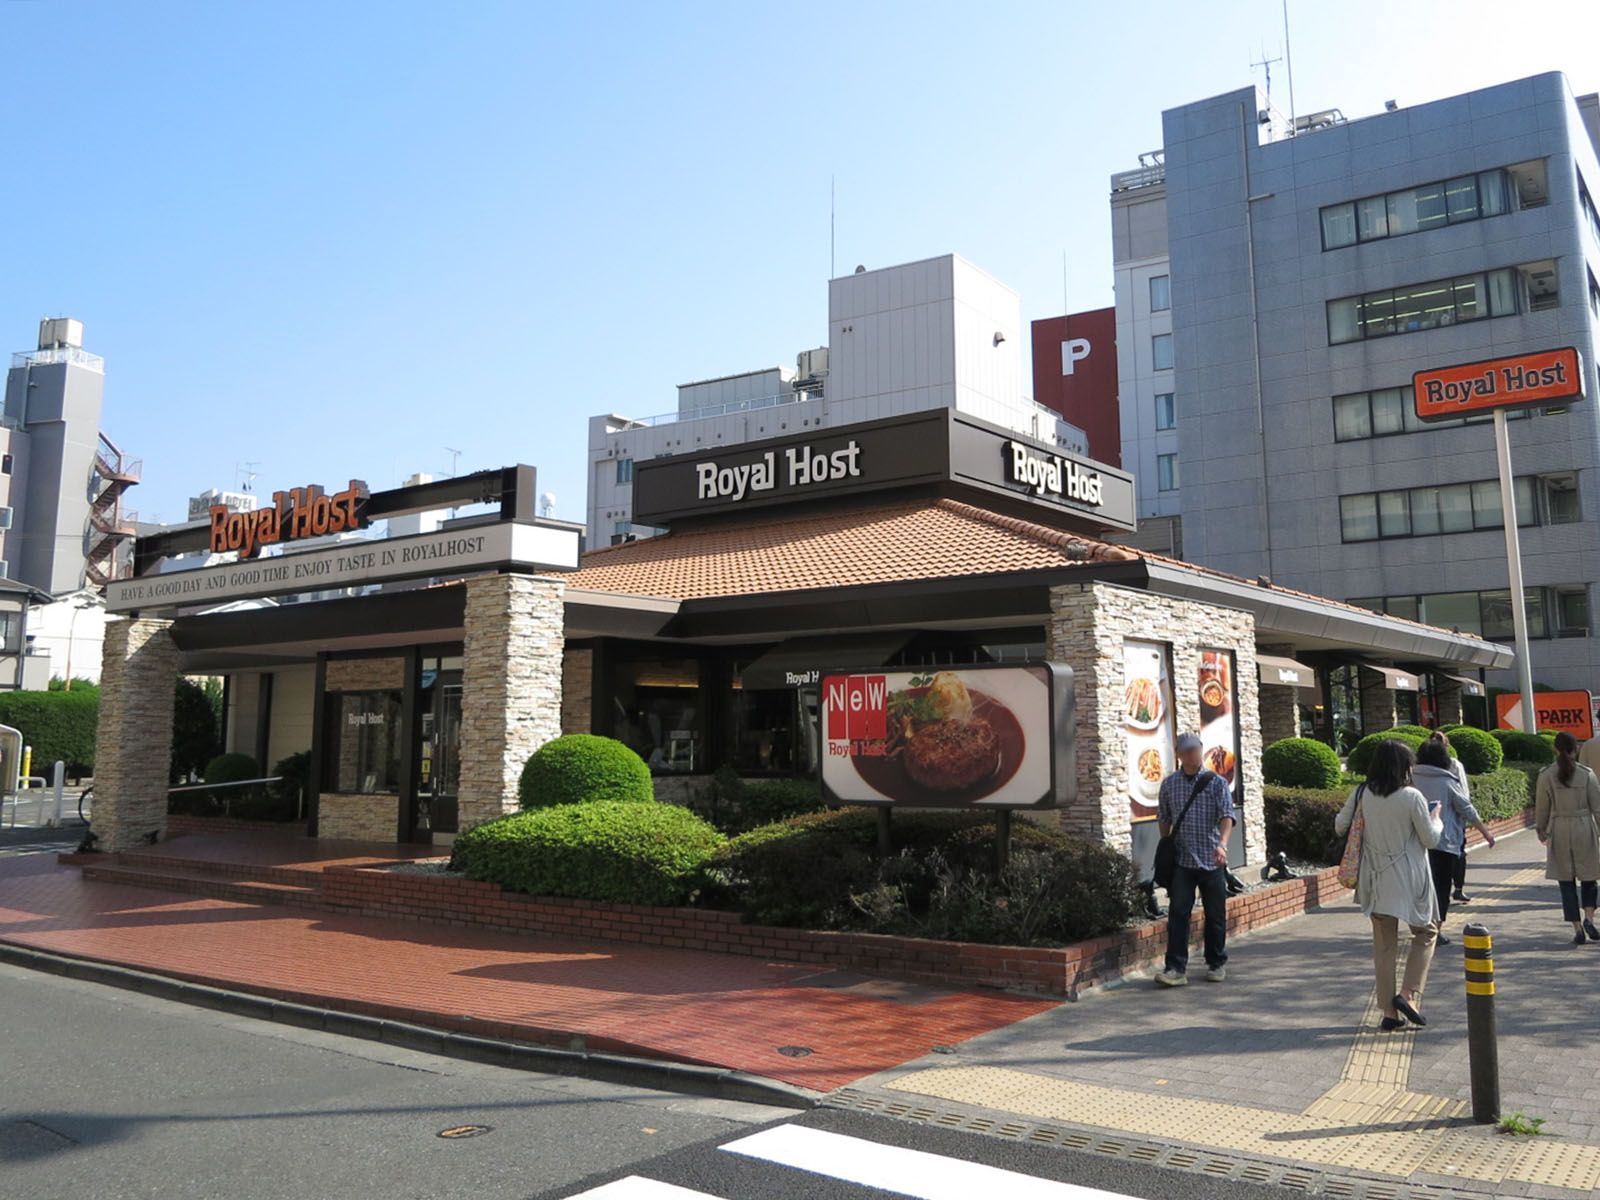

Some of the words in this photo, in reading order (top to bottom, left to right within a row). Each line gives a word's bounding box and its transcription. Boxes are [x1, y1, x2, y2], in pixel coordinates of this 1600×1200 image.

[1061, 338, 1091, 376] P
[1424, 371, 1496, 404] Royal
[1503, 361, 1566, 391] Host
[696, 452, 775, 501] Royal
[785, 441, 861, 486] Host
[1011, 441, 1062, 495] Royal
[1064, 461, 1104, 506] Host
[209, 491, 282, 558] Royal
[289, 479, 362, 538] Host
[121, 587, 144, 601] HAVE
[148, 588, 154, 599] A
[155, 581, 183, 597] GOOD
[183, 579, 202, 593] DAY
[205, 575, 226, 590] AND
[230, 569, 260, 587] GOOD
[262, 565, 290, 583] TIME
[294, 559, 332, 579] ENJOY
[337, 552, 376, 572] TASTE
[382, 549, 396, 566] IN
[402, 536, 485, 563] ROYALHOST
[786, 671, 810, 687] Royal
[348, 712, 366, 727] Royal
[1537, 707, 1585, 725] PARK
